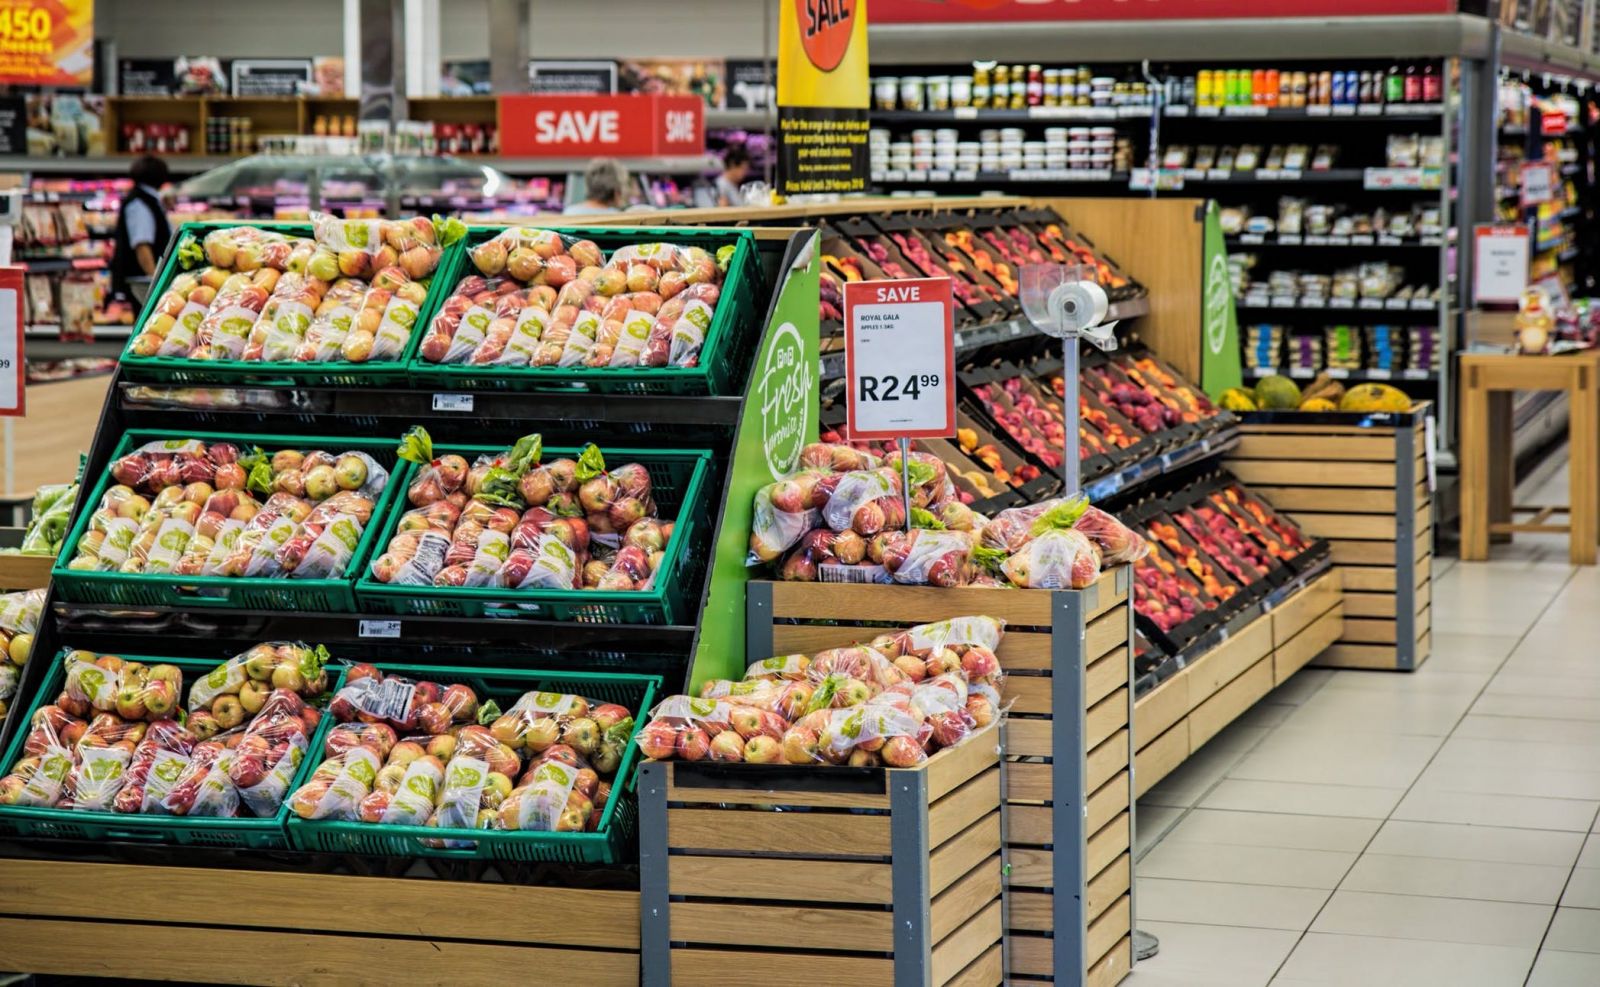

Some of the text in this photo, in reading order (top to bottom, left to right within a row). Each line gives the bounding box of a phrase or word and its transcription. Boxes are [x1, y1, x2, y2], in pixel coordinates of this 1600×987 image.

[535, 110, 620, 144] SAVE
[665, 111, 695, 143] SAVE
[877, 286, 920, 302] SAVE
[882, 313, 900, 321] GALA
[757, 338, 814, 426] Fresh
